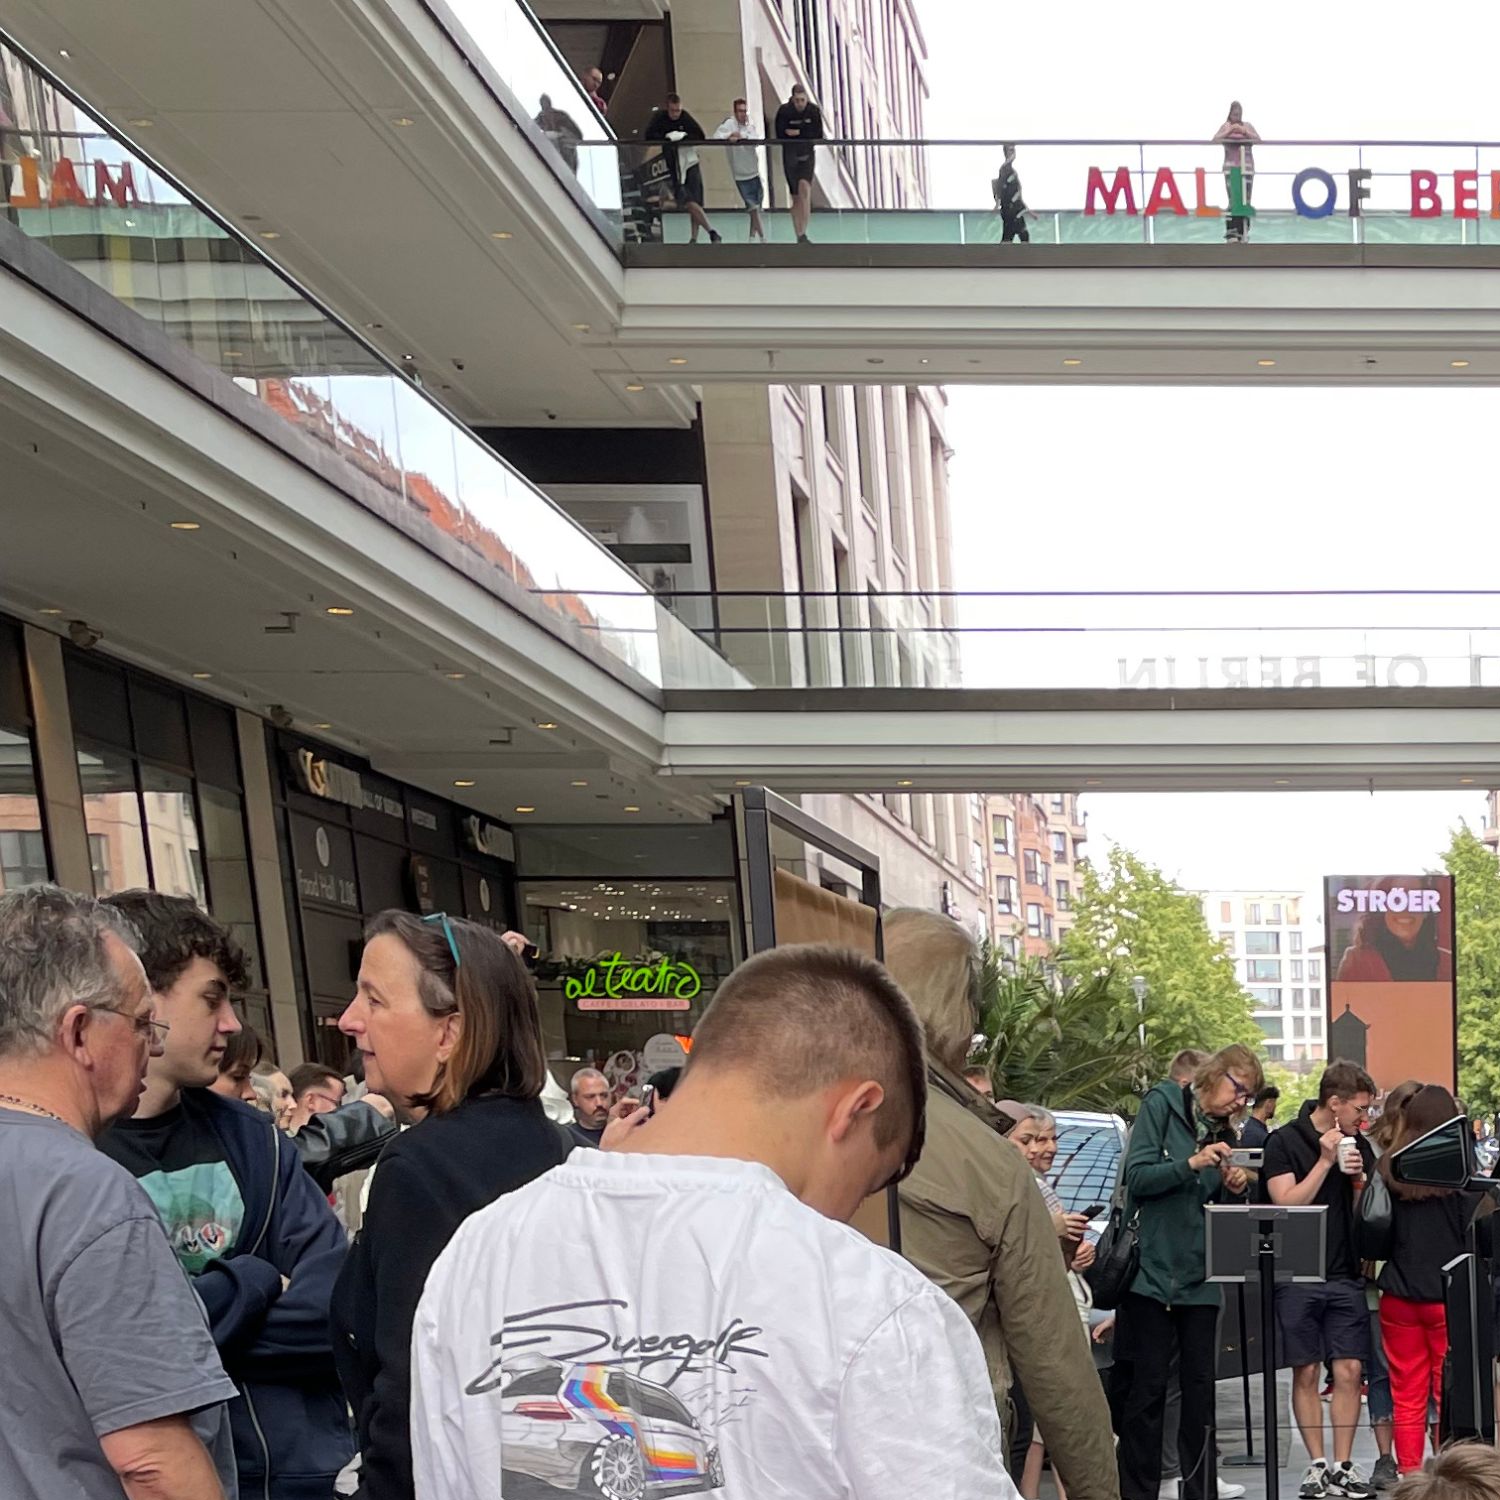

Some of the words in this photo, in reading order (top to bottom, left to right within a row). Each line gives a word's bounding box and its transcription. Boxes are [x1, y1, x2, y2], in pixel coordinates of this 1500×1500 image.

[1084, 166, 1256, 217] MALL
[1292, 166, 1372, 219] OF
[1337, 887, 1441, 913] STRÖER
[565, 967, 606, 999] al
[599, 951, 701, 999] teatro
